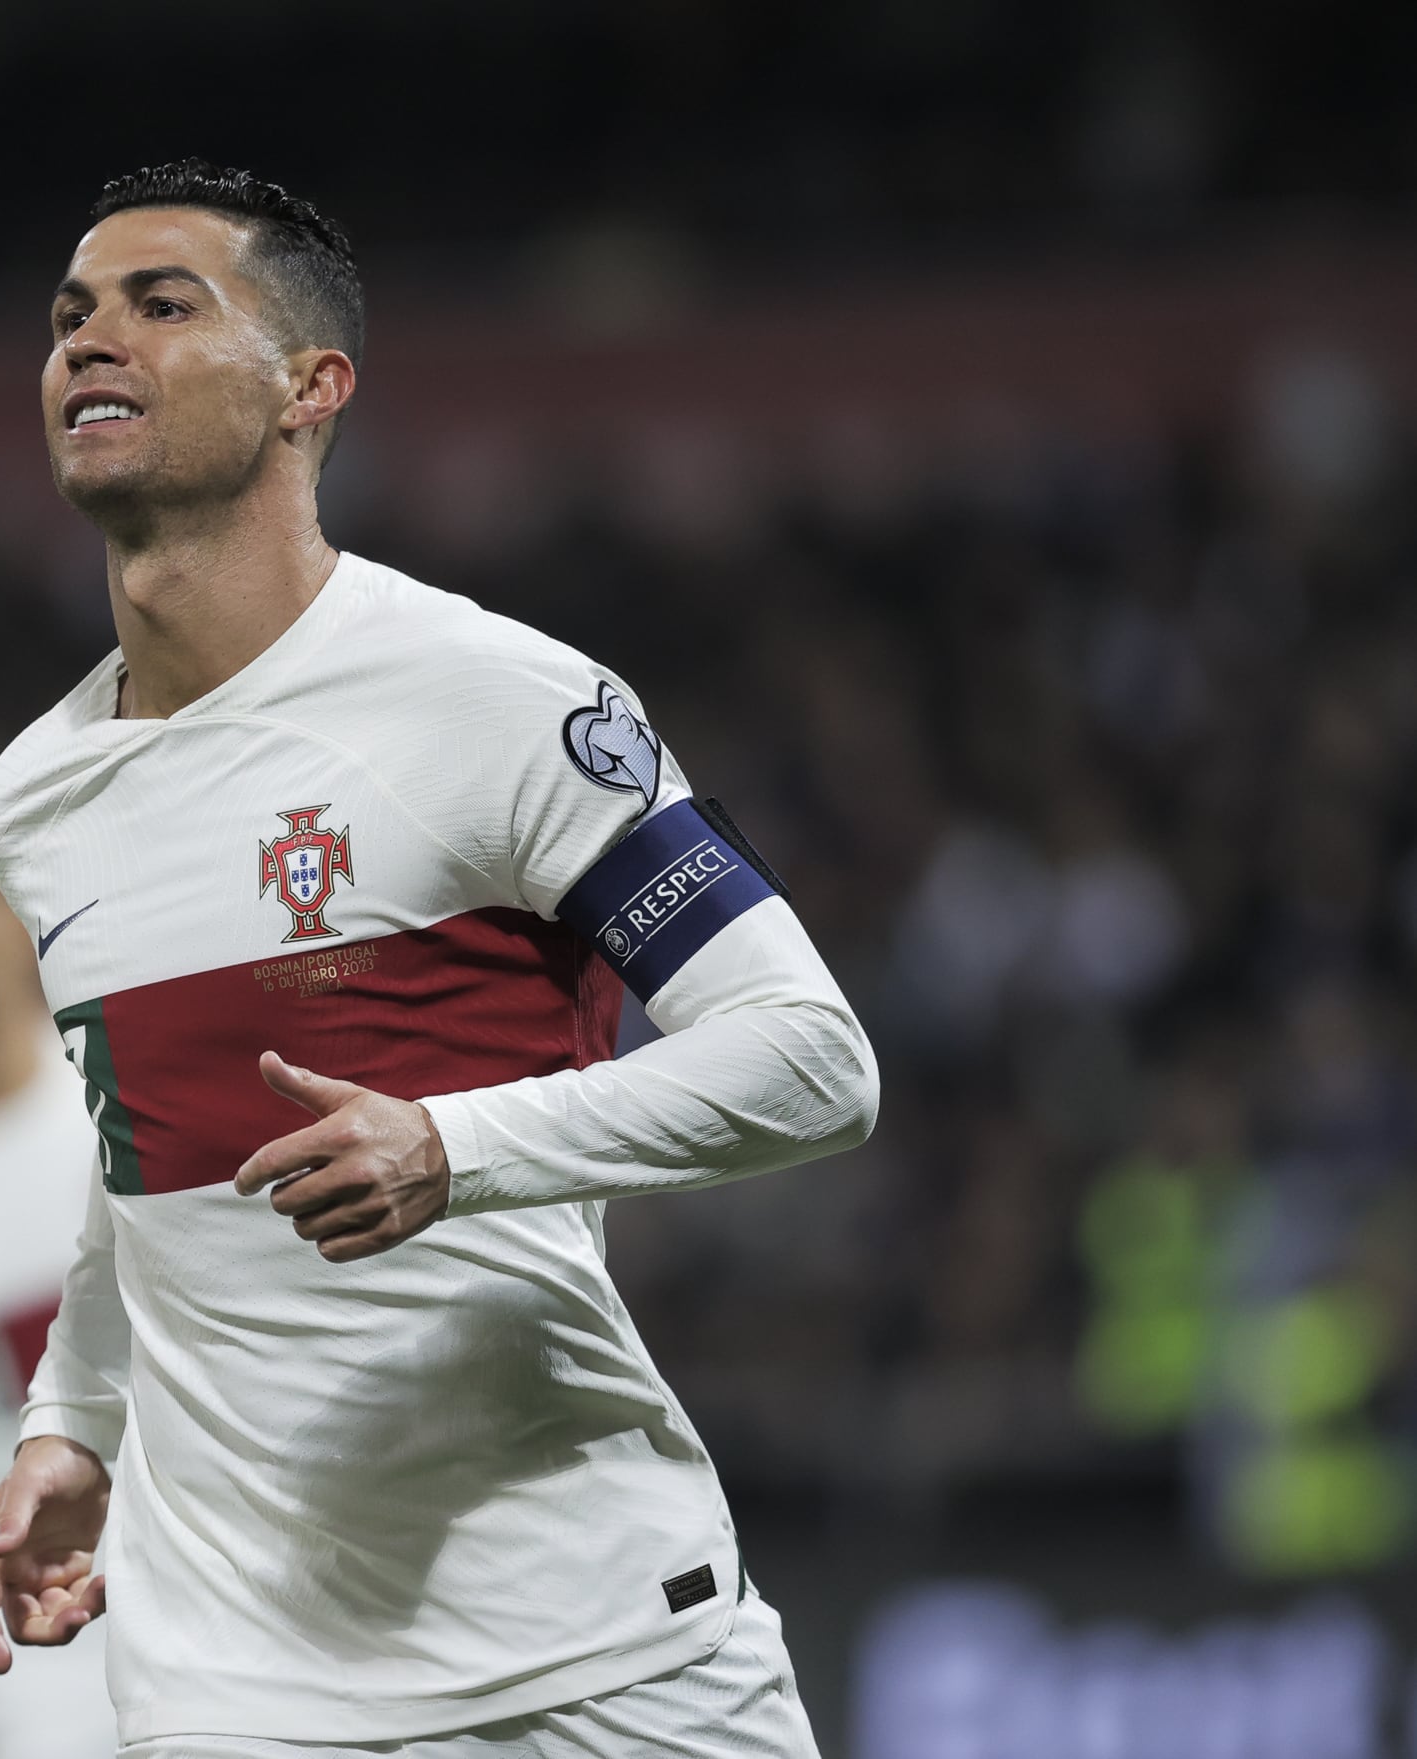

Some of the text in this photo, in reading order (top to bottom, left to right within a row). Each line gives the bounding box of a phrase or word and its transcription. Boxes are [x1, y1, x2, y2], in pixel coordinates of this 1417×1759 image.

[627, 845, 728, 933] RESPECT
[262, 958, 375, 993] 16 OUTUBRO 2023
[298, 978, 345, 999] ZENICA
